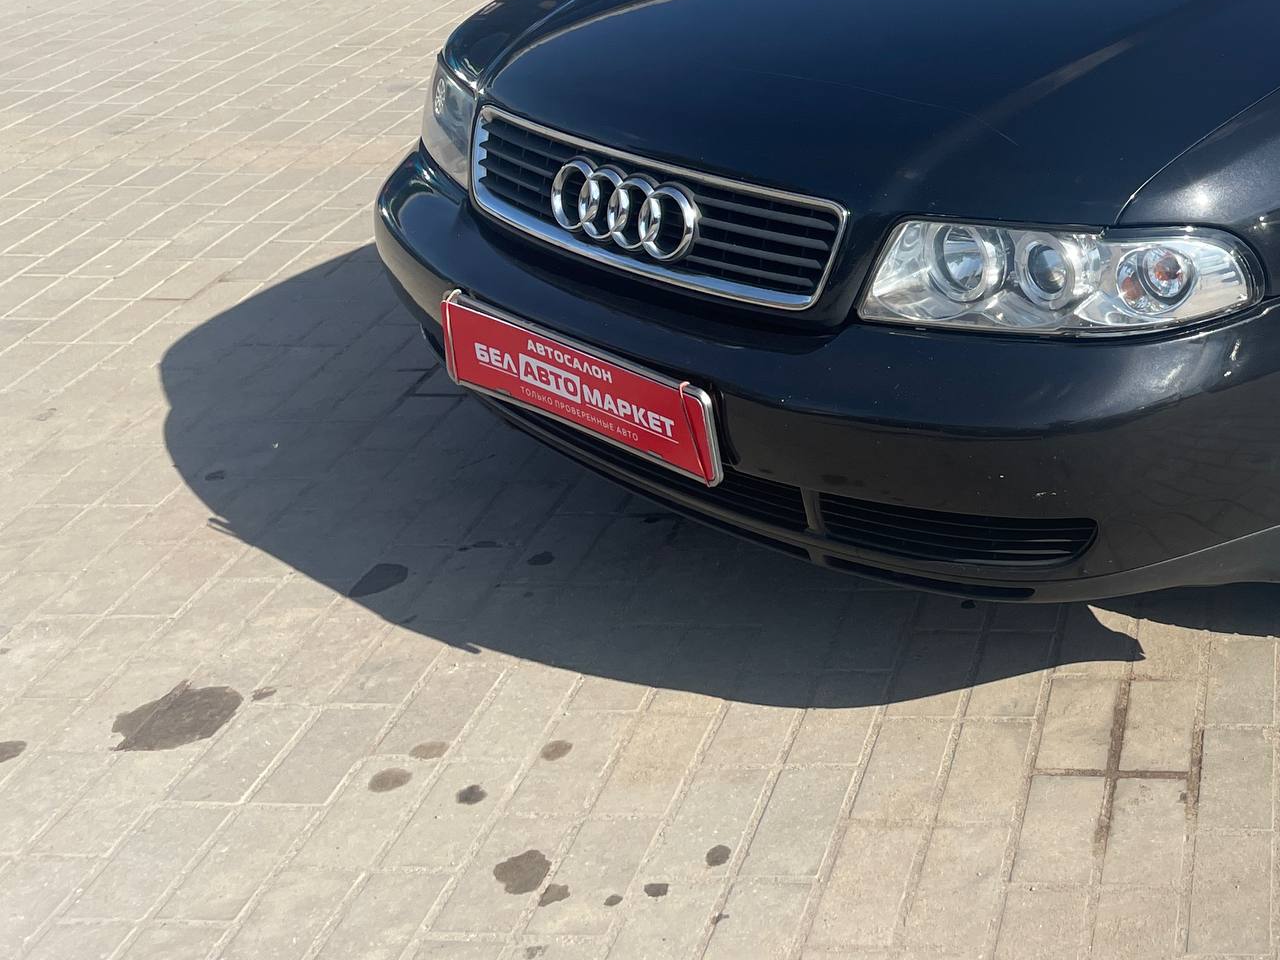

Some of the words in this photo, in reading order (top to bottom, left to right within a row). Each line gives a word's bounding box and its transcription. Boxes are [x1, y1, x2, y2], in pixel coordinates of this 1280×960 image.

[526, 339, 613, 383] АВТОСАЛОН
[520, 386, 553, 405] ТОЛЬКО
[554, 400, 614, 431] ПРОВЕРЕННЫЕ
[615, 425, 639, 442] АВТО
[523, 359, 579, 396] АВТО
[582, 384, 675, 437] МАРКЕТ
